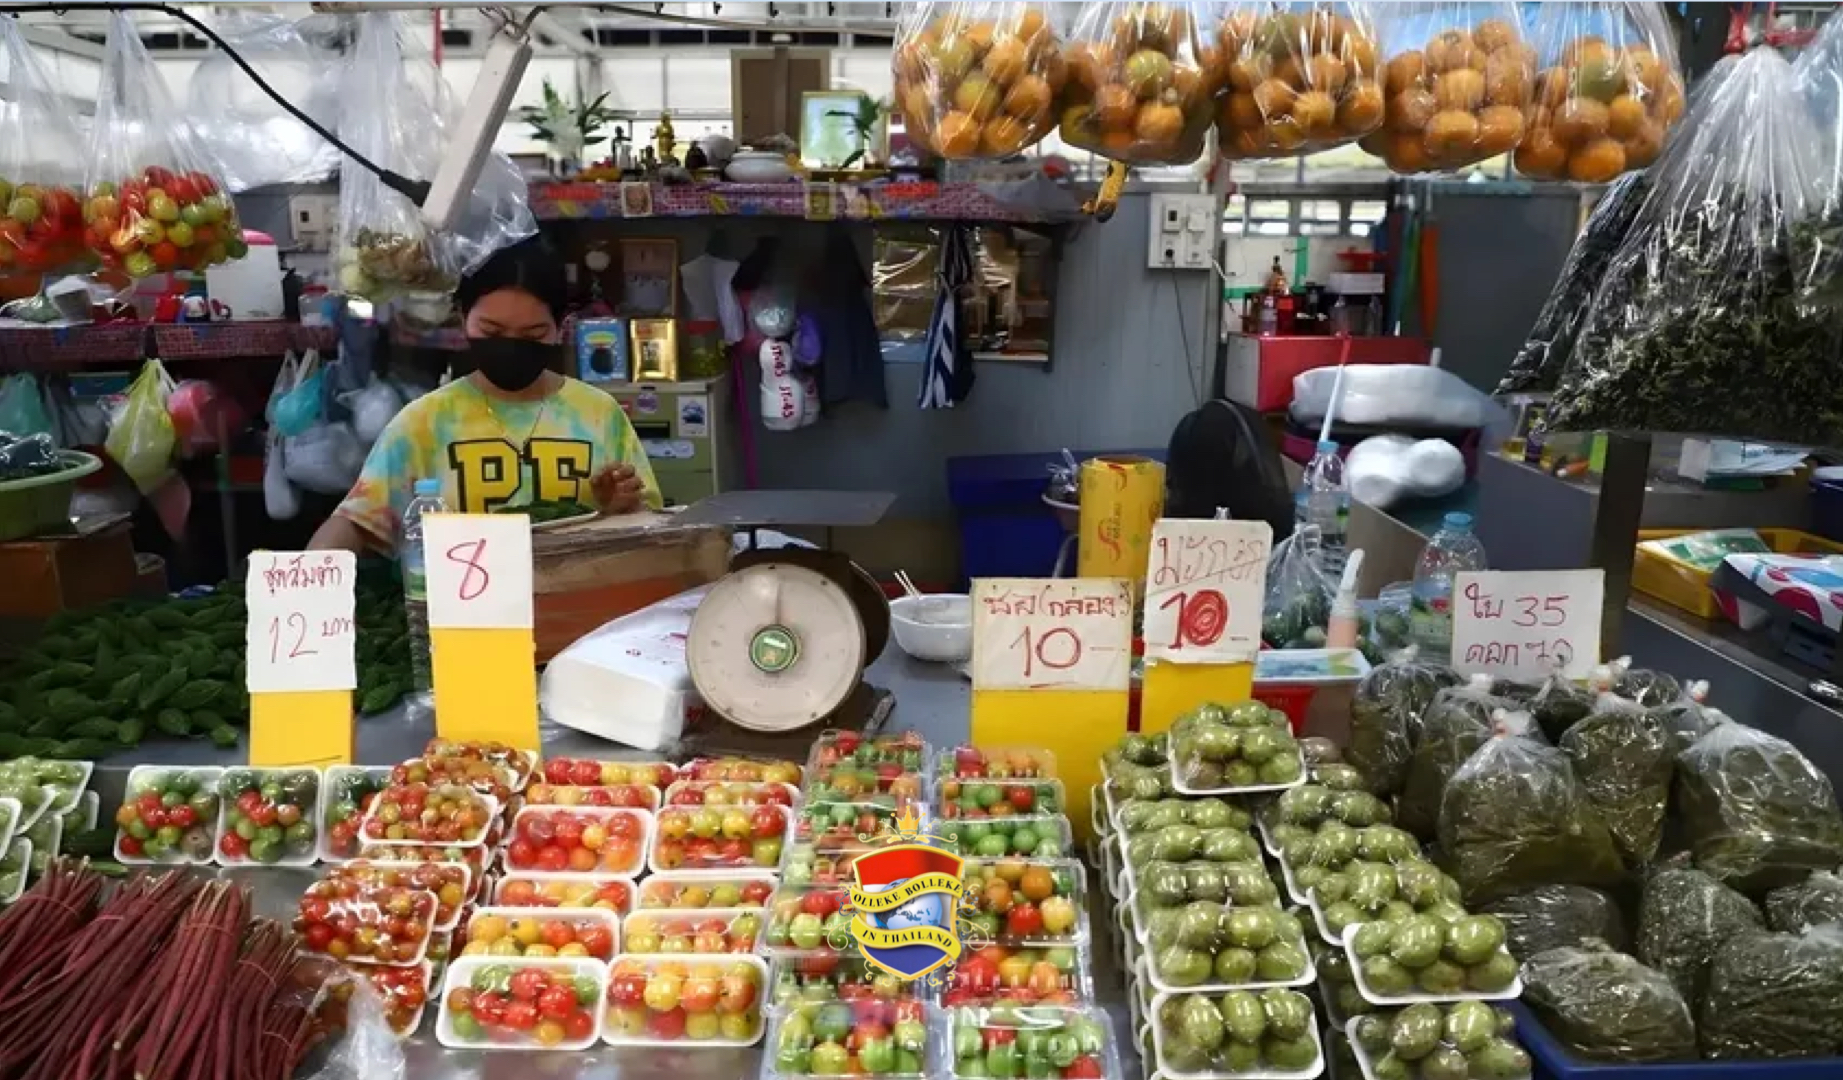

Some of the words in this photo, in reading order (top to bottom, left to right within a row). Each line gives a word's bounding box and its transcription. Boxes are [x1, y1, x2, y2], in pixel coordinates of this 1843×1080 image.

[446, 537, 489, 601] 8
[1464, 582, 1504, 619] ใบ
[1511, 595, 1570, 627] 35
[268, 611, 319, 664] 12
[1464, 640, 1519, 666] ดอก
